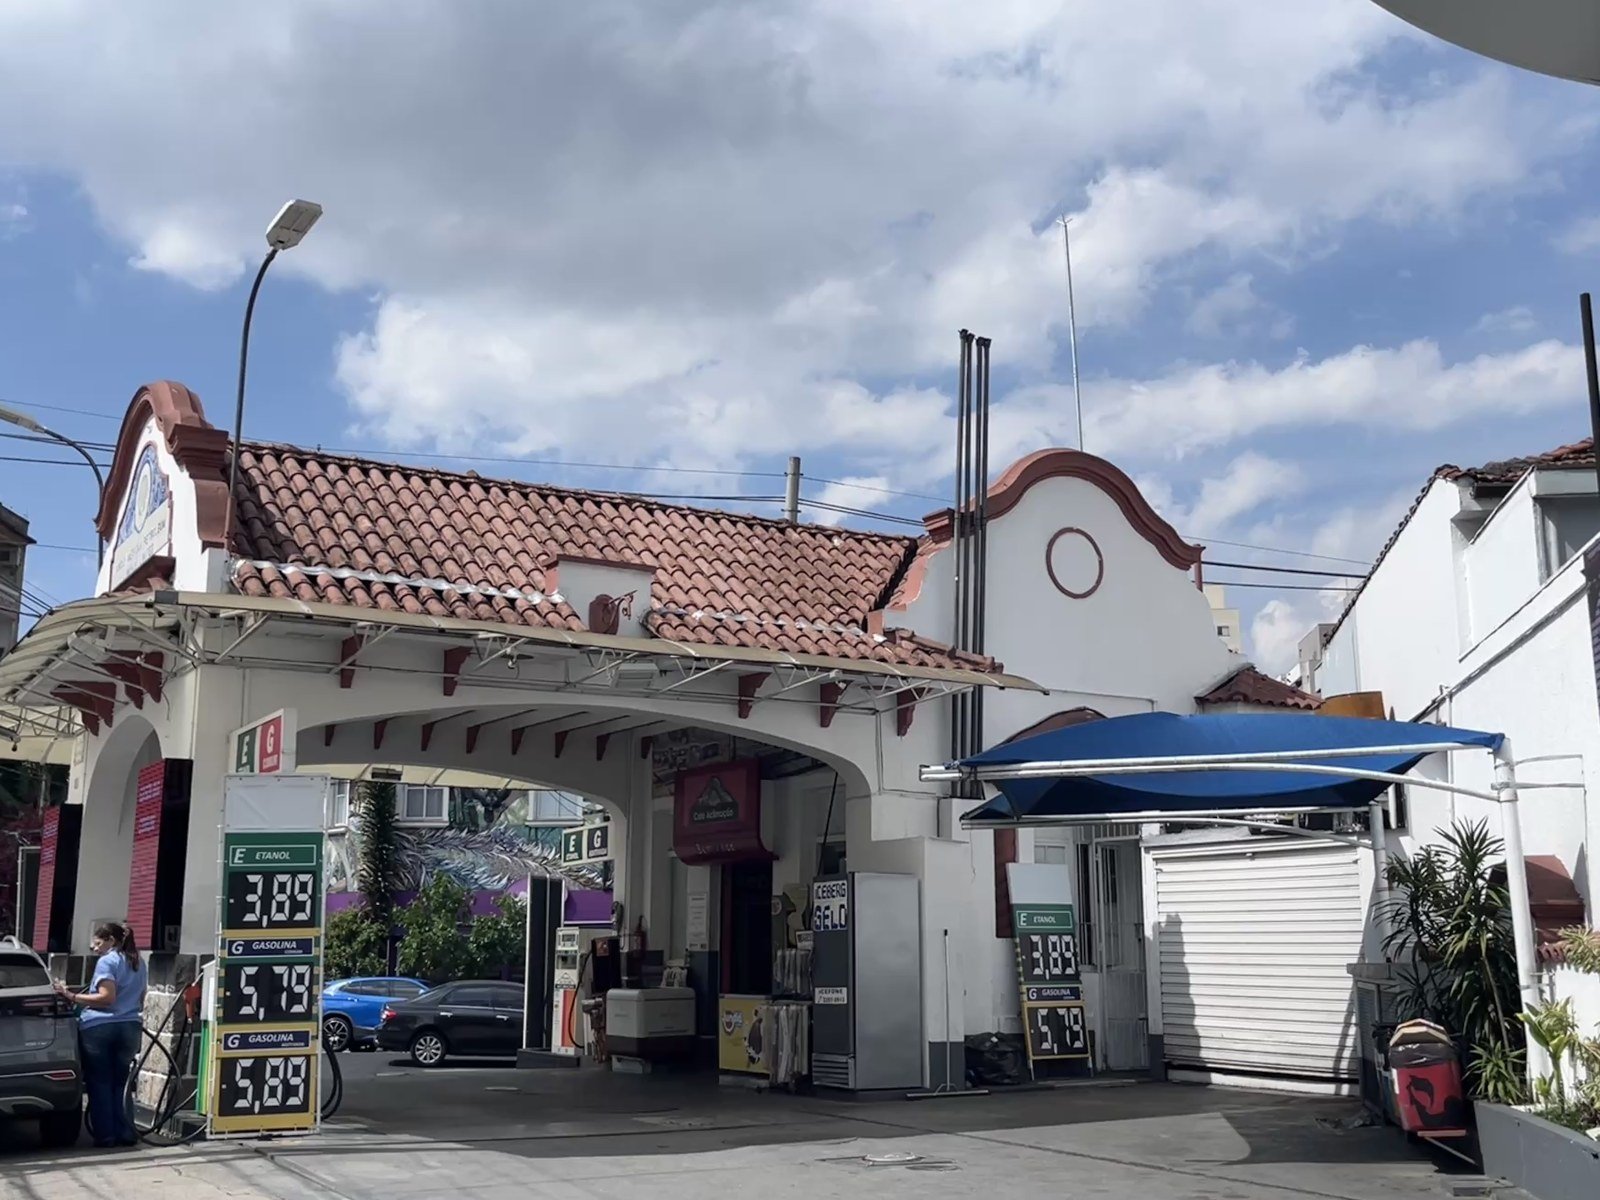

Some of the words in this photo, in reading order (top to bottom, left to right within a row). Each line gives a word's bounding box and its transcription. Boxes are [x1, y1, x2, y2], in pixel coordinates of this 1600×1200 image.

[241, 735, 250, 764] E
[266, 725, 275, 754] G
[569, 834, 577, 852] E
[593, 830, 602, 848] G
[233, 848, 246, 863] E
[255, 851, 290, 860] ETANOL
[242, 874, 314, 928] 3,89
[816, 882, 846, 899] ICEBERG
[815, 904, 847, 930] GELO
[1020, 913, 1028, 926] E
[1033, 916, 1056, 924] ETANOL
[231, 941, 245, 955] G
[252, 941, 297, 950] GASOLINA
[1030, 934, 1076, 980] 3,89
[238, 965, 311, 1021] 5,79
[1028, 988, 1038, 1000] G
[1041, 988, 1071, 996] GASOLINA
[227, 1034, 241, 1048] G
[248, 1033, 294, 1043] GASOLINA
[1037, 1008, 1084, 1055] 5,79
[233, 1056, 307, 1114] 5,89
